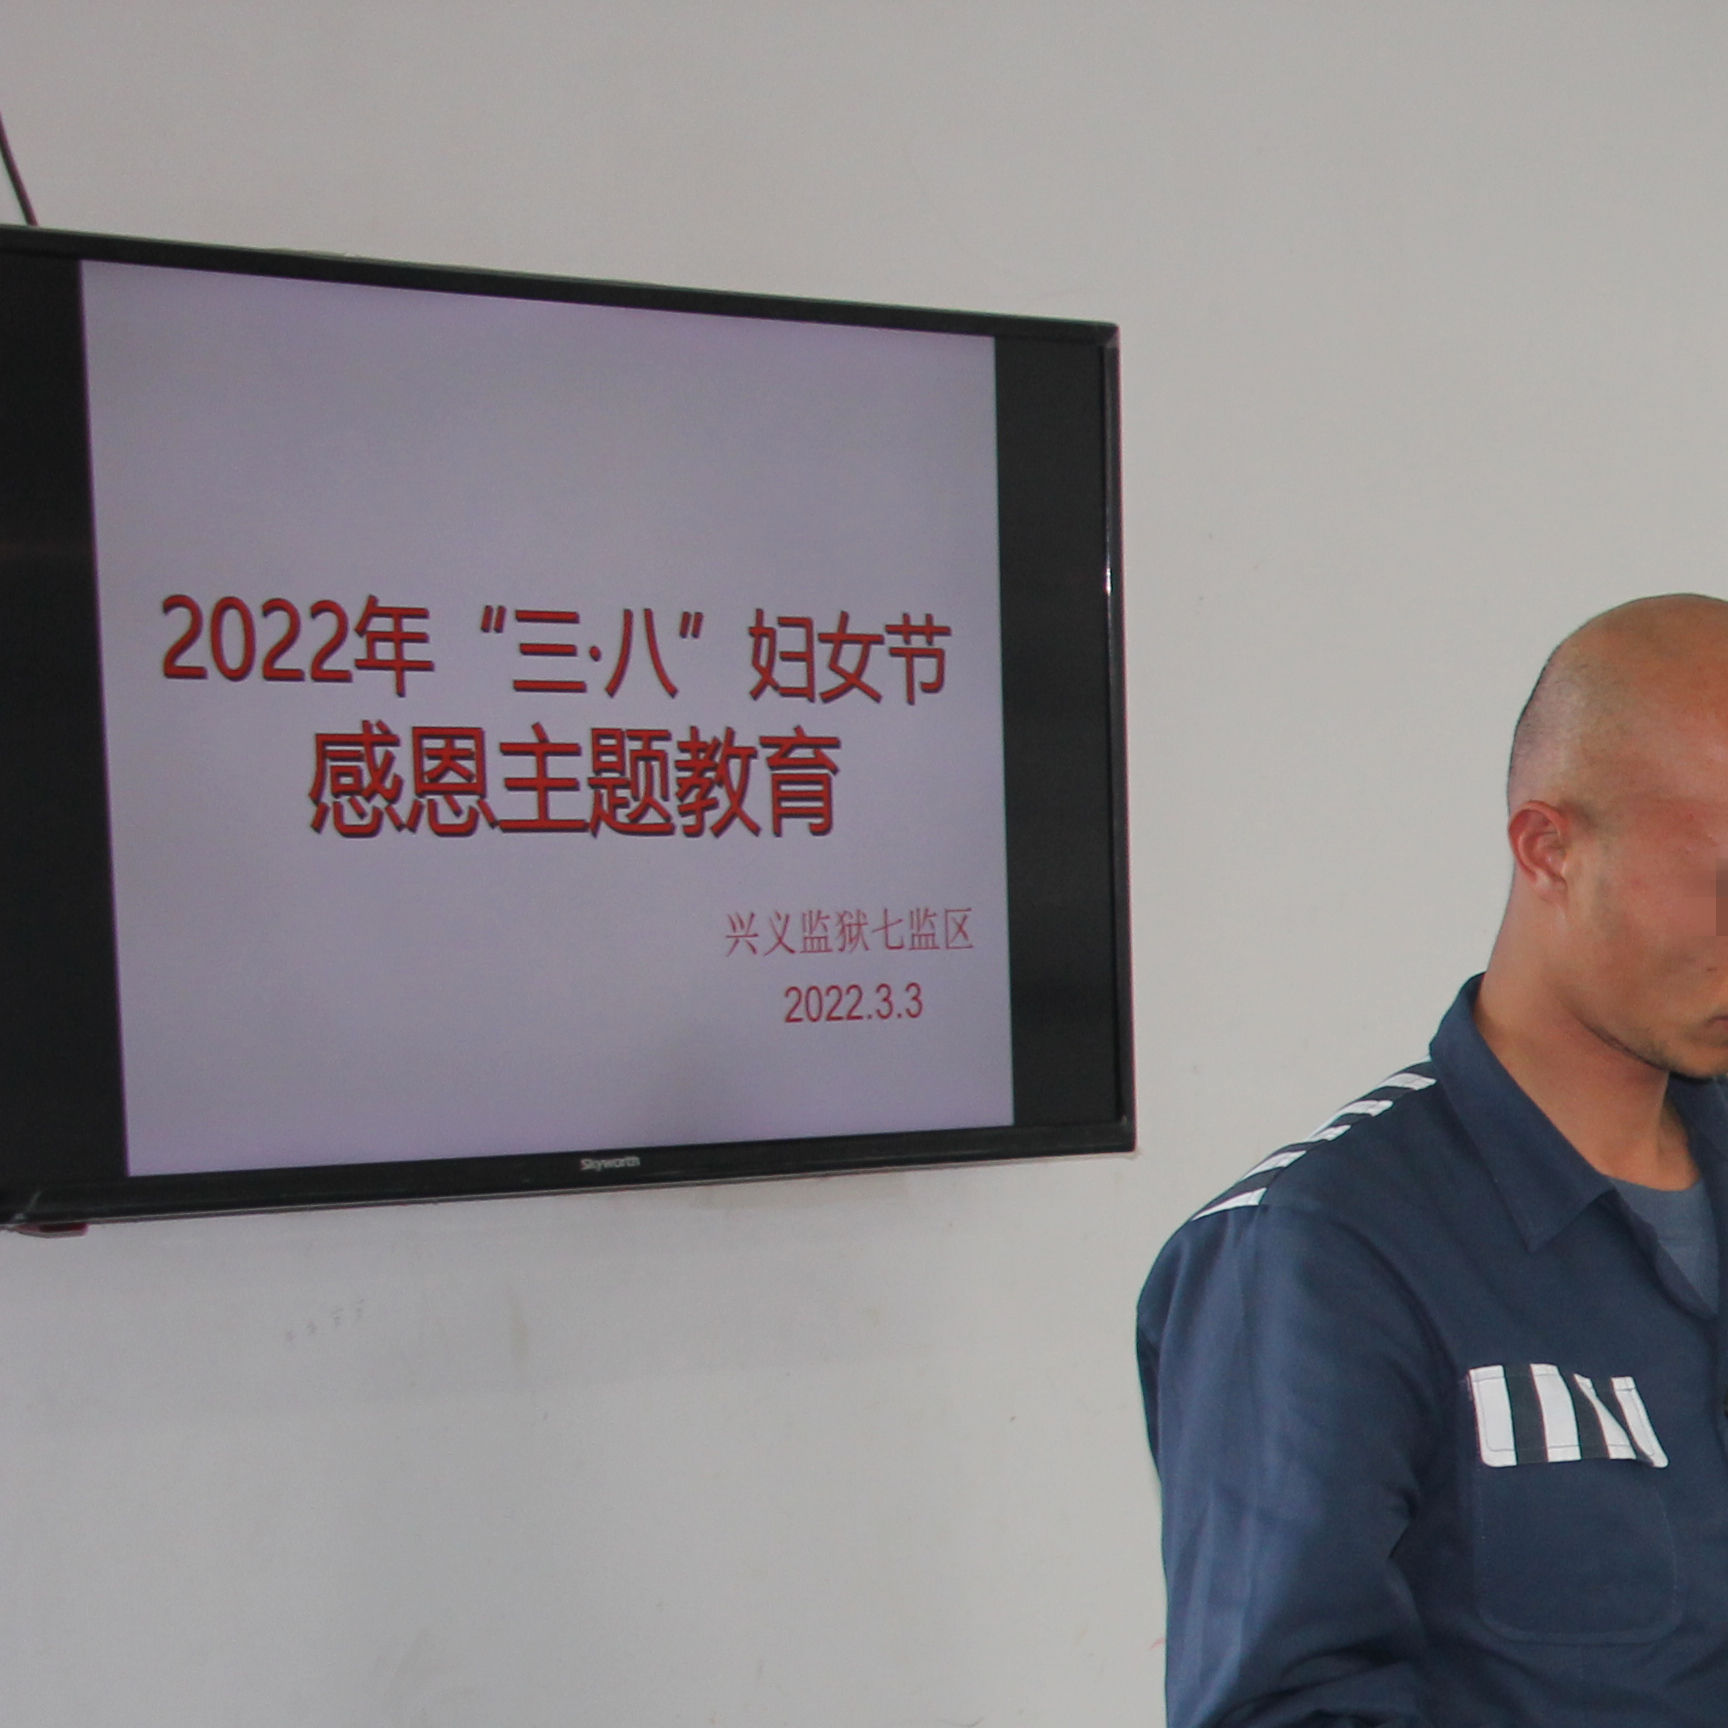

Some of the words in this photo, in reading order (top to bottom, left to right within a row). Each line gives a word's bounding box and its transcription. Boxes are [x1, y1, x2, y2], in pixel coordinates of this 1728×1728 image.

[309, 720, 843, 839] 感恩主题教育
[725, 907, 974, 957] 兴义监狱七监区
[784, 982, 924, 1024] 2022.3.3
